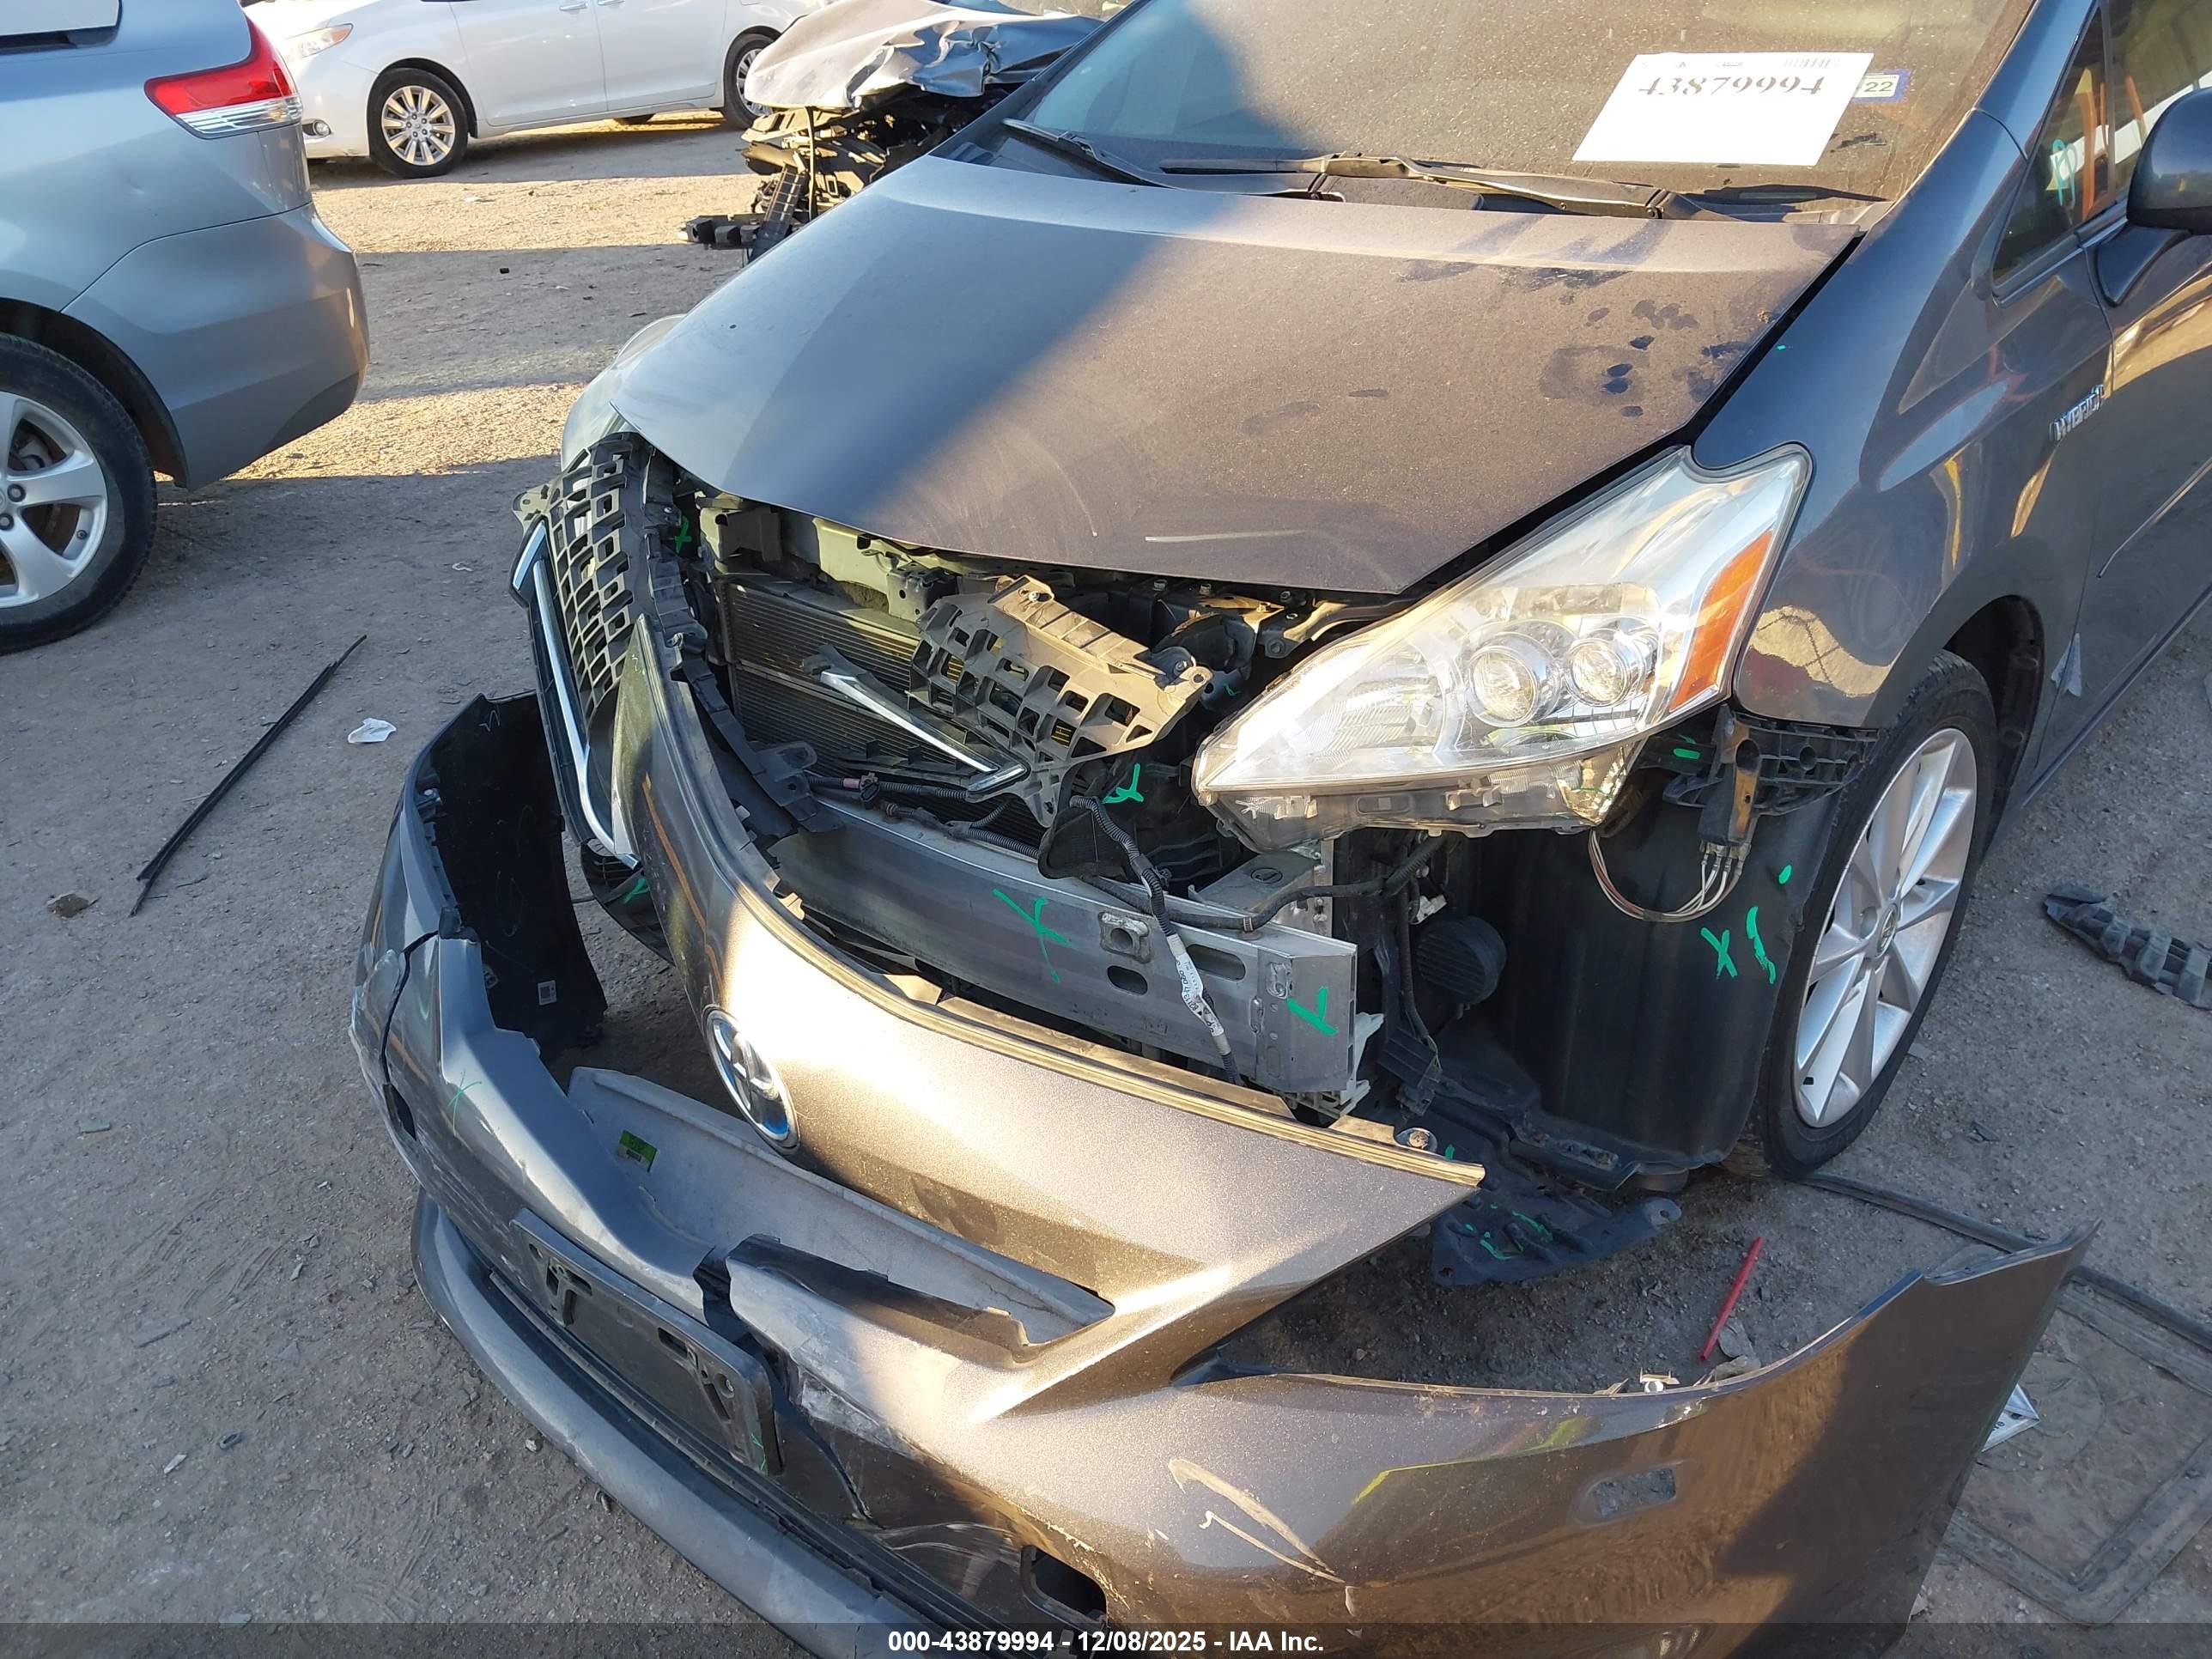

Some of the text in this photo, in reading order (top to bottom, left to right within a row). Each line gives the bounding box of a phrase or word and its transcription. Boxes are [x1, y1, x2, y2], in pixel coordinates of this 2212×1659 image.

[1638, 76, 1826, 96] 43879994
[1863, 81, 1894, 93] 22
[2053, 392, 2100, 441] HYBRID
